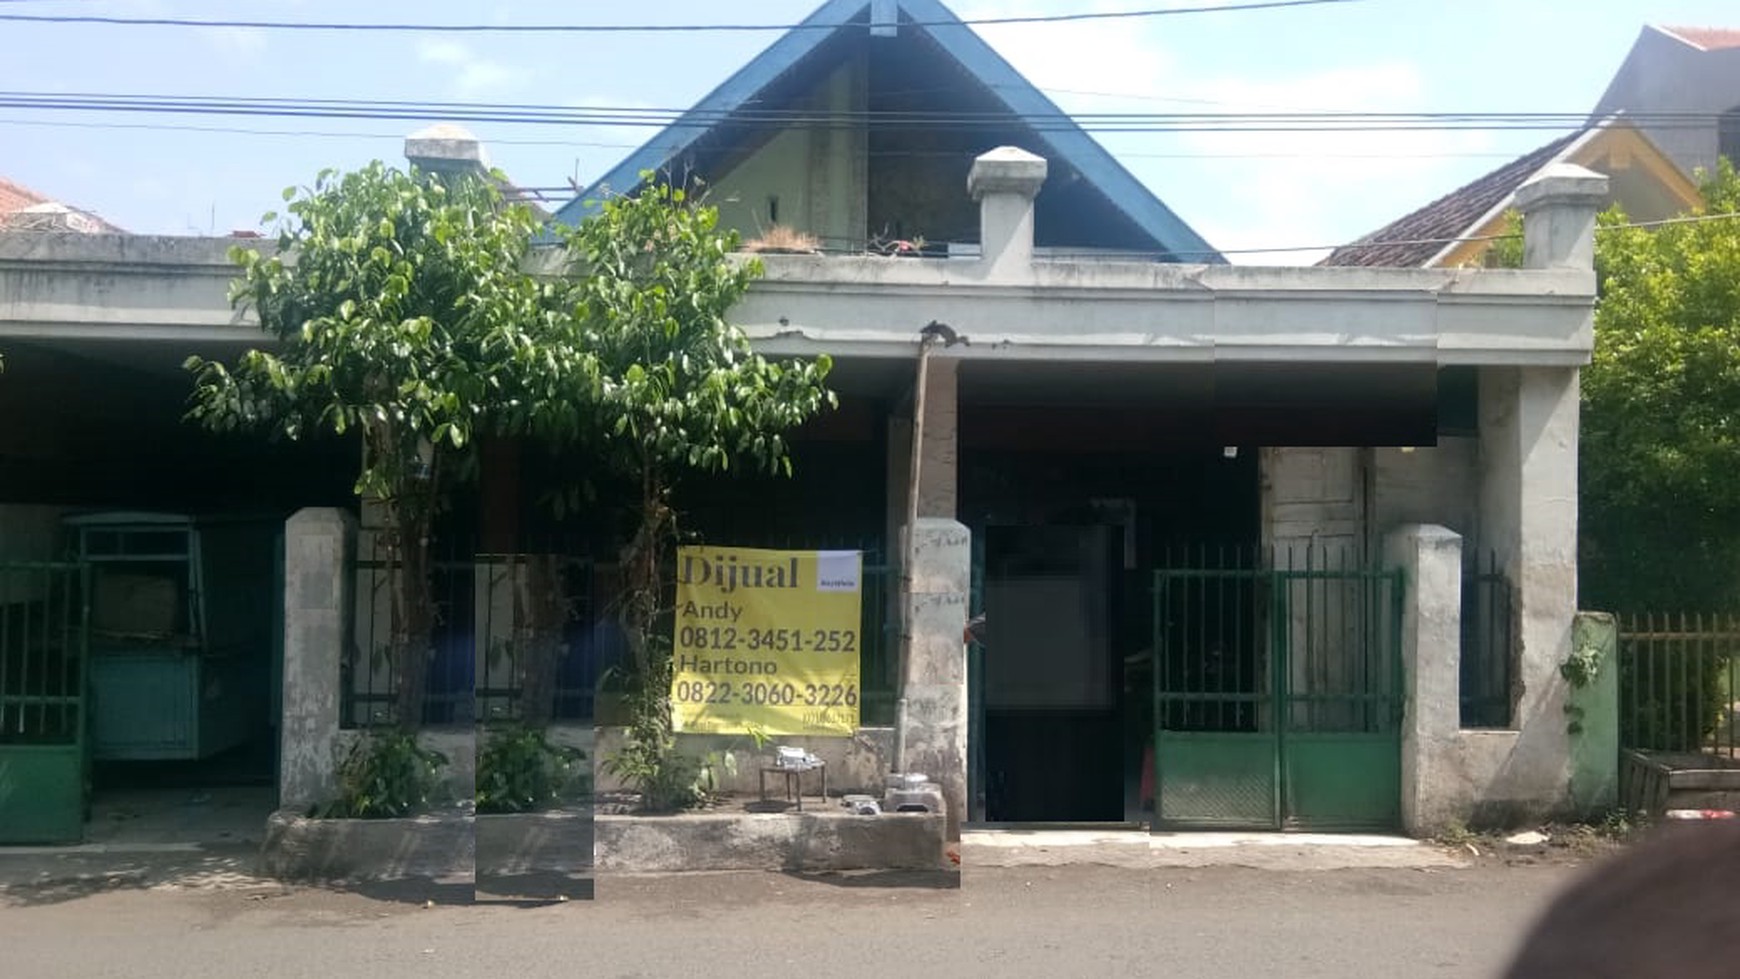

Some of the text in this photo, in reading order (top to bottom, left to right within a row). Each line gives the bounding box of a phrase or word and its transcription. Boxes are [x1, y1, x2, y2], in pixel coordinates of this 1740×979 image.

[683, 555, 798, 594] Dijual
[682, 601, 743, 622] Andy
[680, 626, 856, 652] 0812-3451-252
[680, 654, 778, 675] Hartono
[677, 680, 857, 707] 0822-3060-3226
